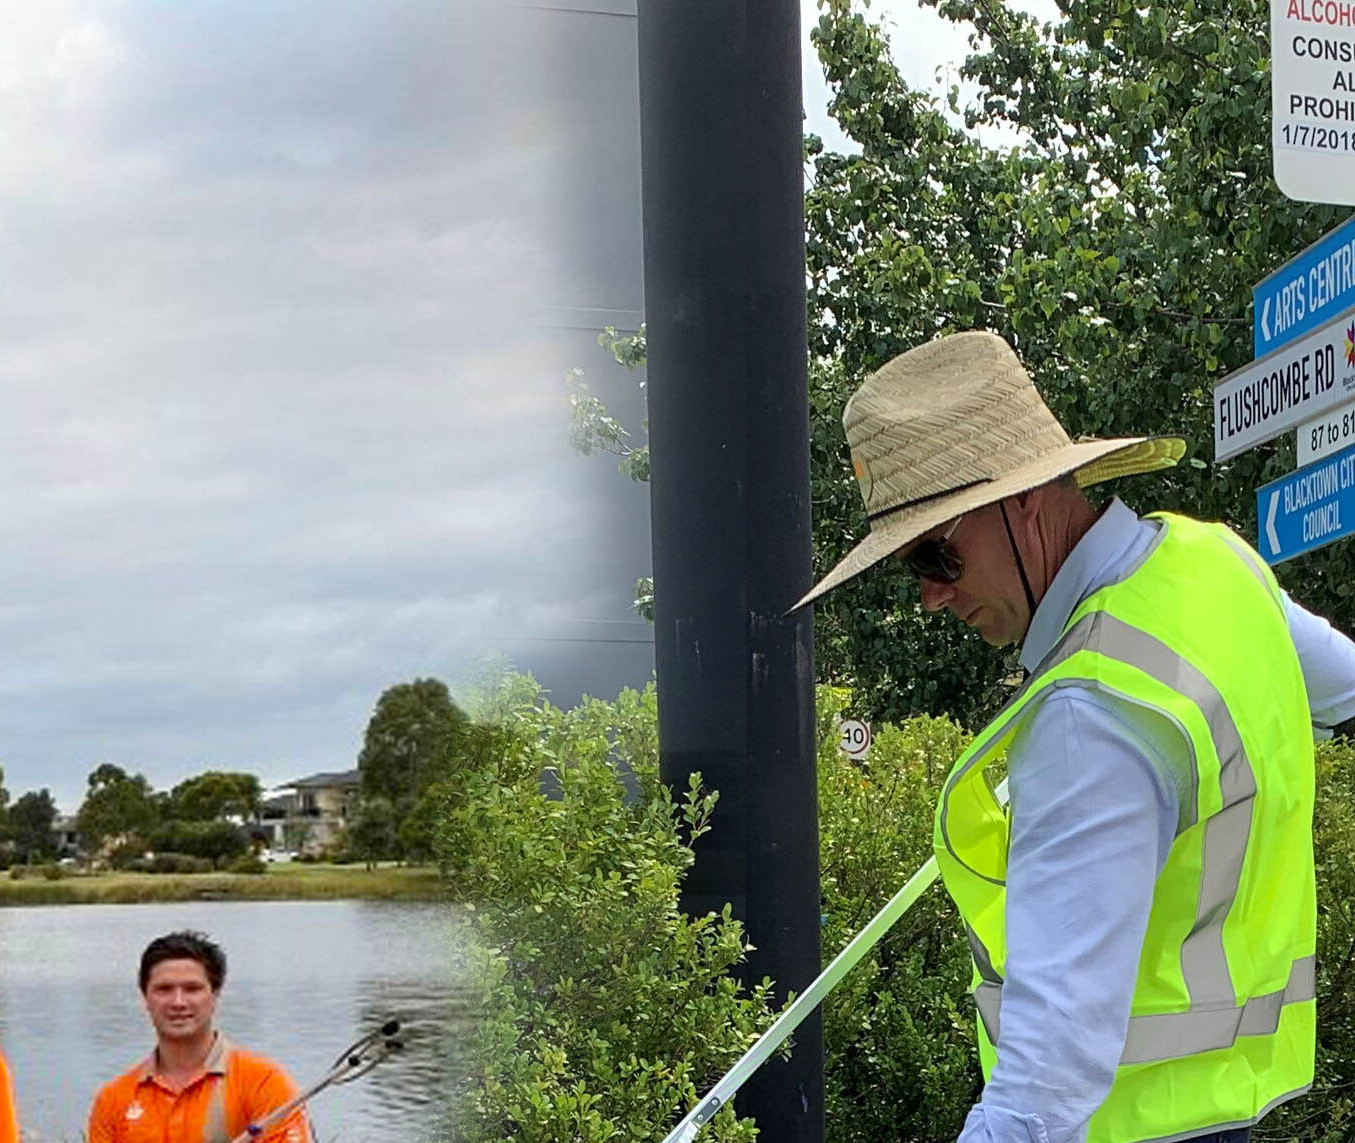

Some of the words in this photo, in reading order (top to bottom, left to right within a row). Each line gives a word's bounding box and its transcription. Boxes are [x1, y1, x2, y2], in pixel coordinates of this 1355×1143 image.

[1287, 0, 1355, 27] ALCOH
[1293, 36, 1355, 62] CONS
[1273, 275, 1305, 338] ARTS
[1219, 355, 1310, 441] FLUSHCOMBE
[1315, 344, 1334, 395] RD
[1311, 428, 1324, 451] 87
[1327, 422, 1339, 443] to
[1342, 409, 1355, 437] 81
[1284, 462, 1339, 515] BLACKTOWN
[1303, 500, 1342, 543] COUNCIL
